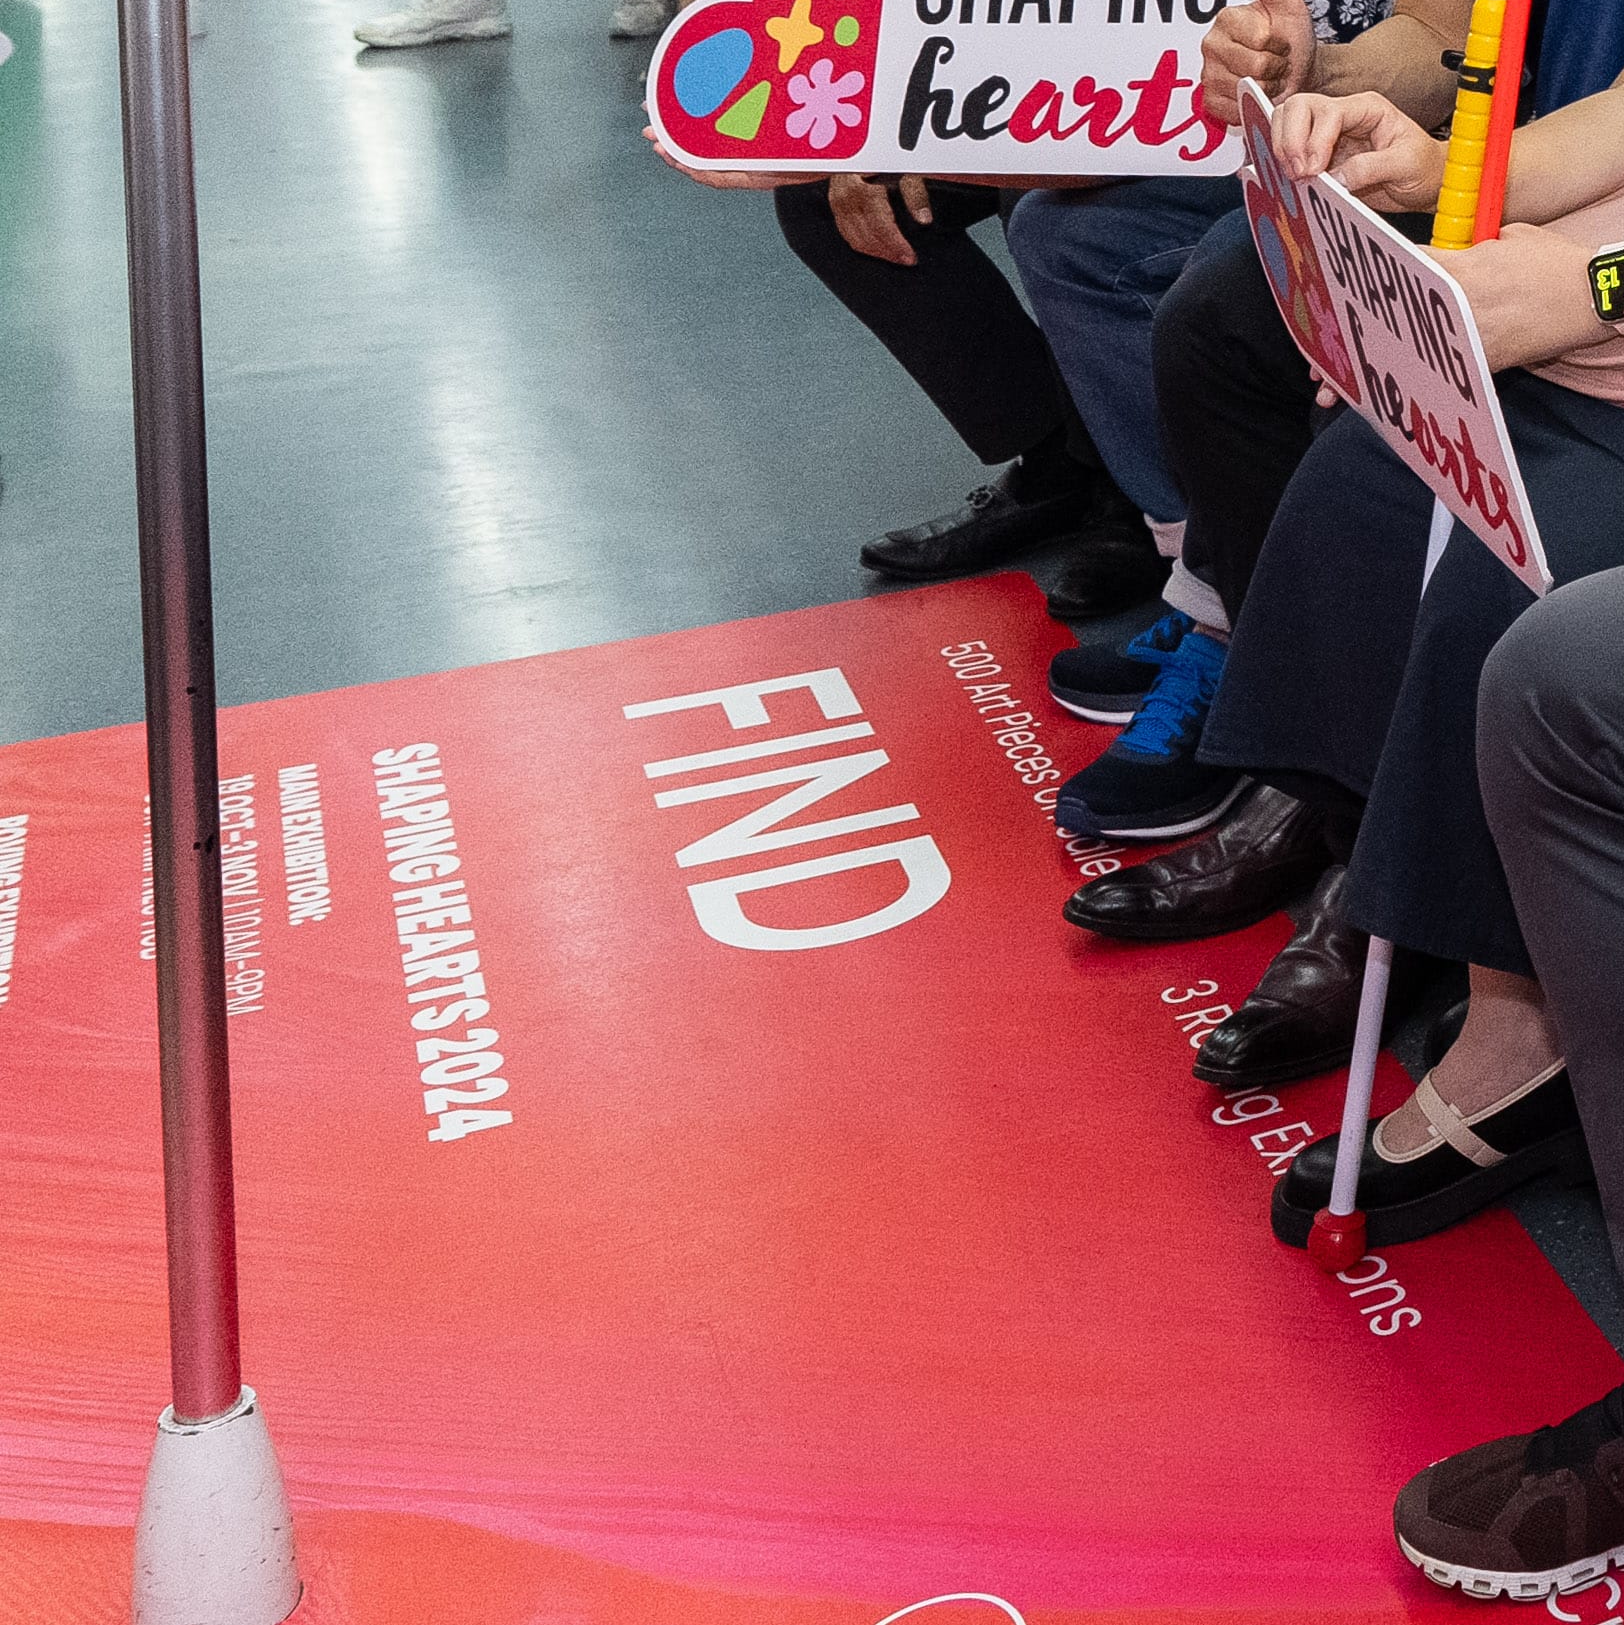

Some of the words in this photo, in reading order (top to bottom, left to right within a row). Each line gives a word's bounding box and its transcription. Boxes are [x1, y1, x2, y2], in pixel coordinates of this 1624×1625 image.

[899, 35, 1228, 162] hearts
[1308, 184, 1478, 409] SHAPING
[1345, 299, 1527, 568] hearts
[940, 639, 1002, 680] 500
[963, 682, 1023, 715] Art
[218, 774, 256, 793] 19
[277, 763, 322, 816] MAIN
[985, 711, 1061, 785] Pieces
[371, 742, 462, 883] SHAPING
[623, 666, 952, 952] FIND
[221, 853, 259, 897] NOV
[281, 808, 332, 926] EXHIBITION:
[392, 879, 491, 1031] HEARTS
[1160, 978, 1219, 1005] 3
[415, 1028, 513, 1143] 2024
